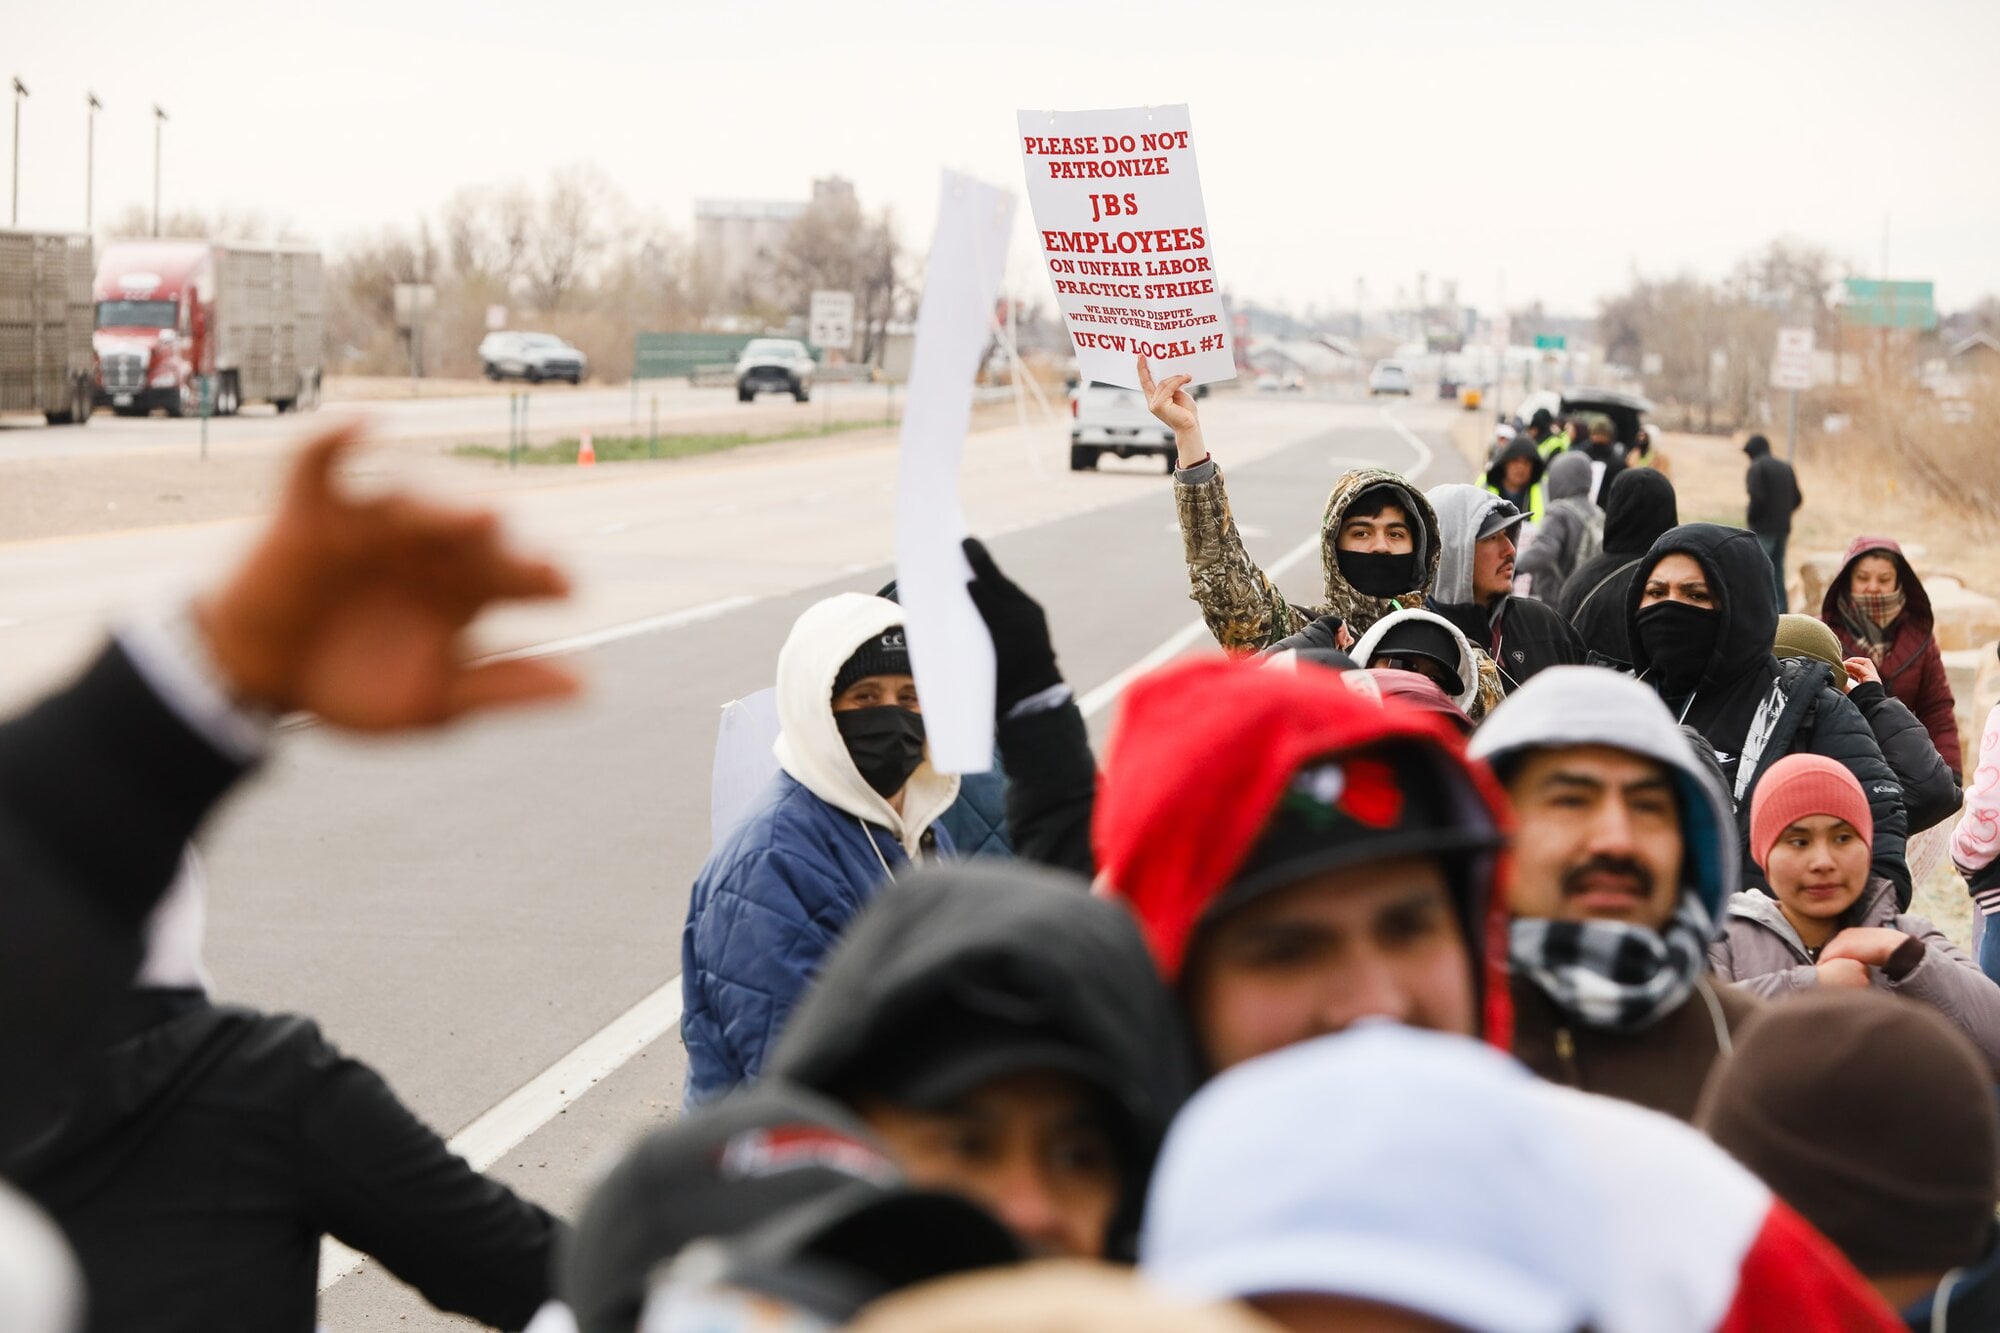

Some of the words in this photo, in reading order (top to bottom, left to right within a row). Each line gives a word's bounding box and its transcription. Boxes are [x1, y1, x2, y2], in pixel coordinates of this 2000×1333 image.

[1024, 137, 1099, 155] PLEASE
[1102, 135, 1136, 153] DO
[1141, 131, 1188, 151] NOT
[1049, 157, 1169, 179] PATRONIZE
[1089, 193, 1138, 222] JBS
[1042, 227, 1205, 254] EMPLOYEES
[1050, 259, 1075, 274] ON
[1078, 261, 1143, 277] UNFAIR
[1145, 257, 1211, 276] LABOR
[1056, 280, 1141, 299] PRACTICE
[1144, 279, 1214, 299] STRIKE
[1070, 313, 1096, 322] WITH
[1098, 315, 1121, 323] ANY
[1120, 318, 1151, 329] OTHER
[1153, 314, 1217, 330] EMPLOYER
[1085, 305, 1104, 314] WE
[1103, 307, 1128, 316] HAVE
[1130, 309, 1144, 318] NO
[1147, 308, 1192, 320] DISPUTE
[1073, 332, 1126, 352] UFCW
[1130, 338, 1196, 360] LOCAL
[1200, 333, 1224, 352] #7
